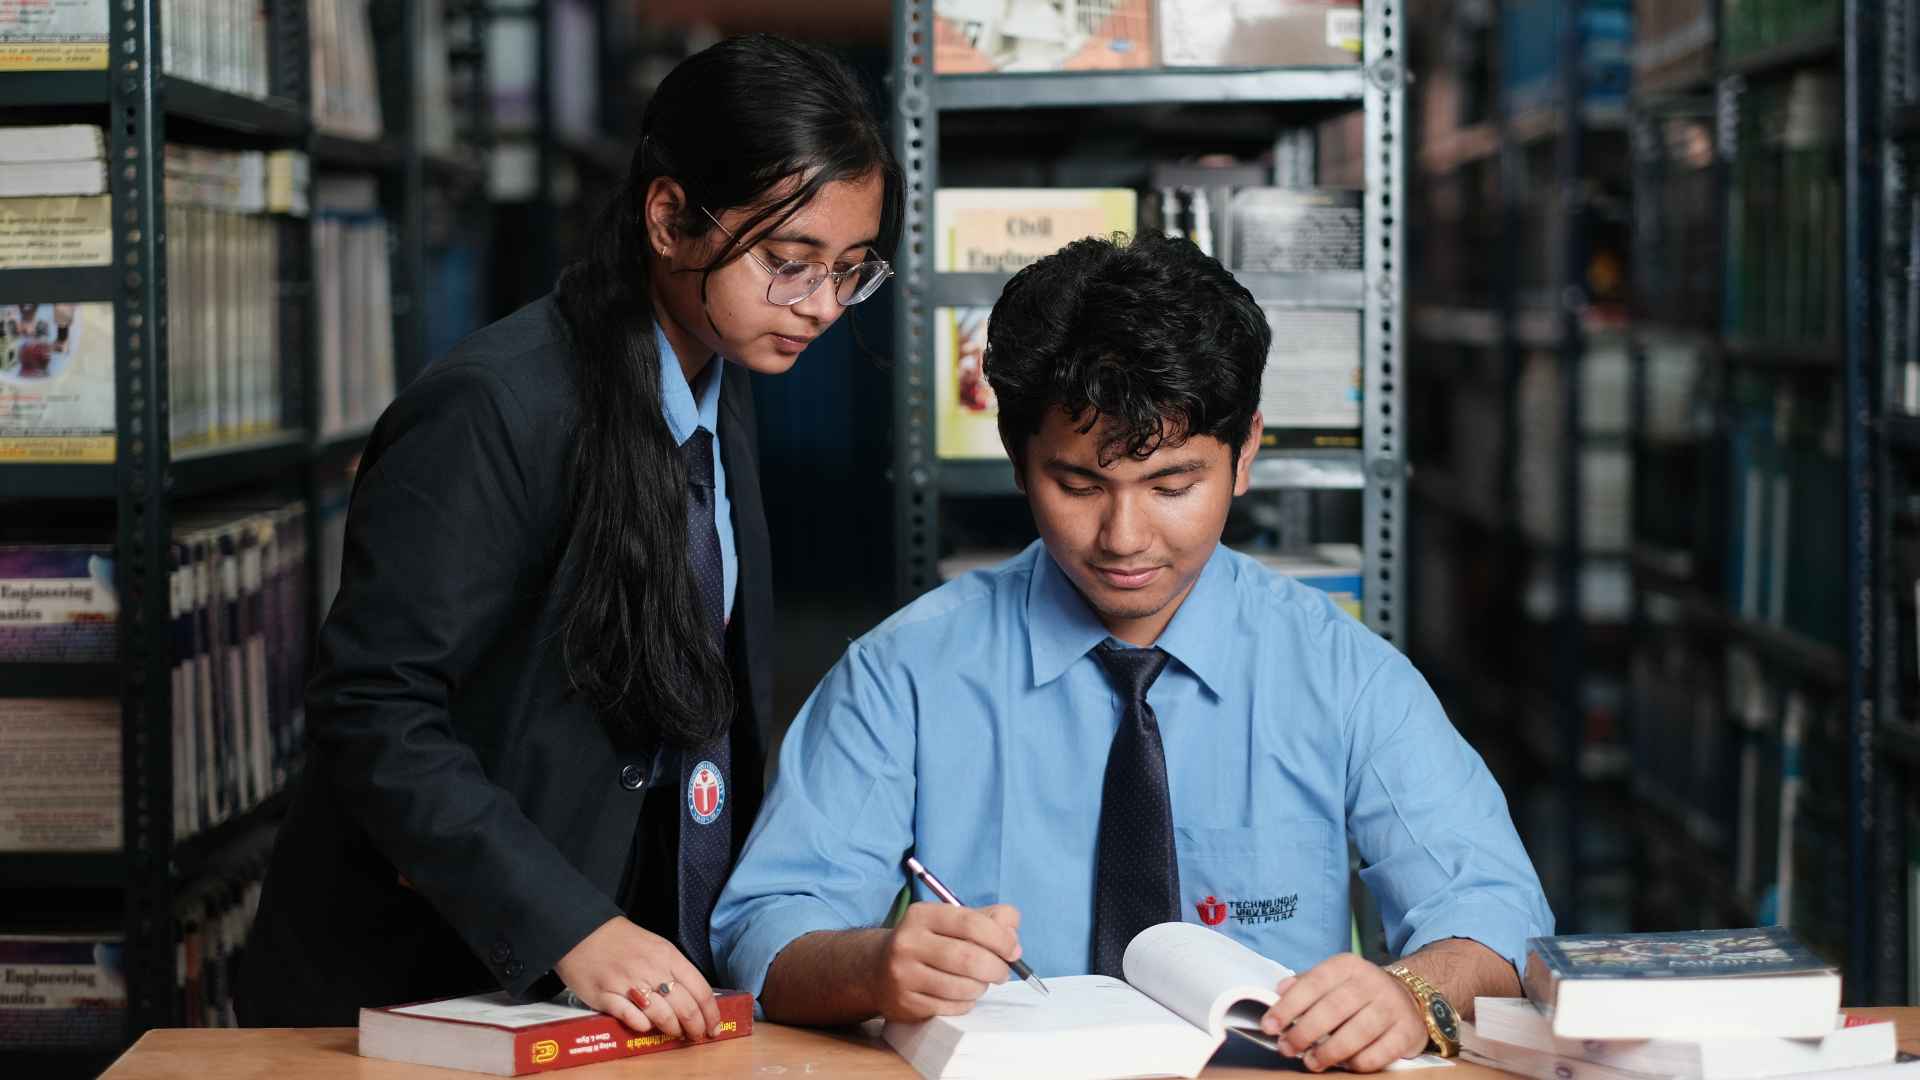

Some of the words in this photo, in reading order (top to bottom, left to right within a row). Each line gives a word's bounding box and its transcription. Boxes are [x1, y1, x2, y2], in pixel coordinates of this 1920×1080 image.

[1006, 215, 1053, 237] Civil
[1, 583, 94, 604] Engineering
[5, 967, 97, 988] Engineering
